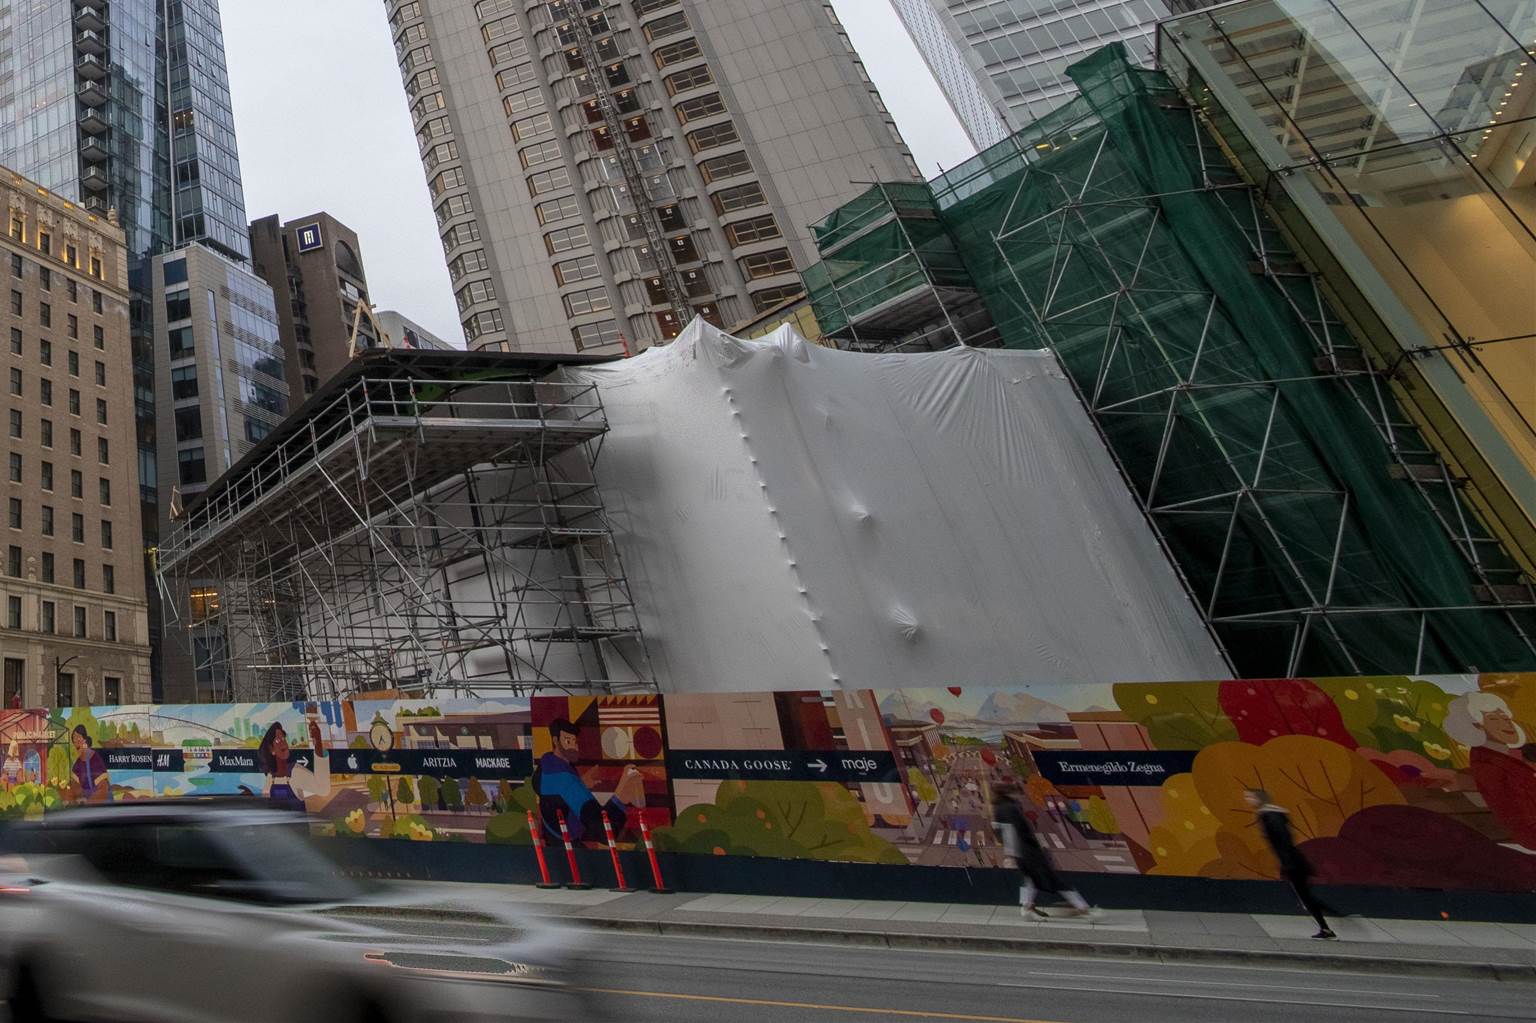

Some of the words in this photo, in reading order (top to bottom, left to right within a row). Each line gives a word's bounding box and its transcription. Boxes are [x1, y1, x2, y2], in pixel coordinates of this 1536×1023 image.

[109, 754, 131, 764] HARRY
[131, 754, 152, 763] ROSEN
[219, 756, 254, 767] MaxMara
[423, 757, 457, 768] ARITZIA
[475, 757, 511, 768] MACKAGE
[841, 757, 878, 772] maje
[684, 759, 740, 770] CANADA
[743, 760, 792, 771] GOOSE
[1057, 761, 1129, 775] Ermenegildo
[1127, 761, 1165, 775] Zegna
